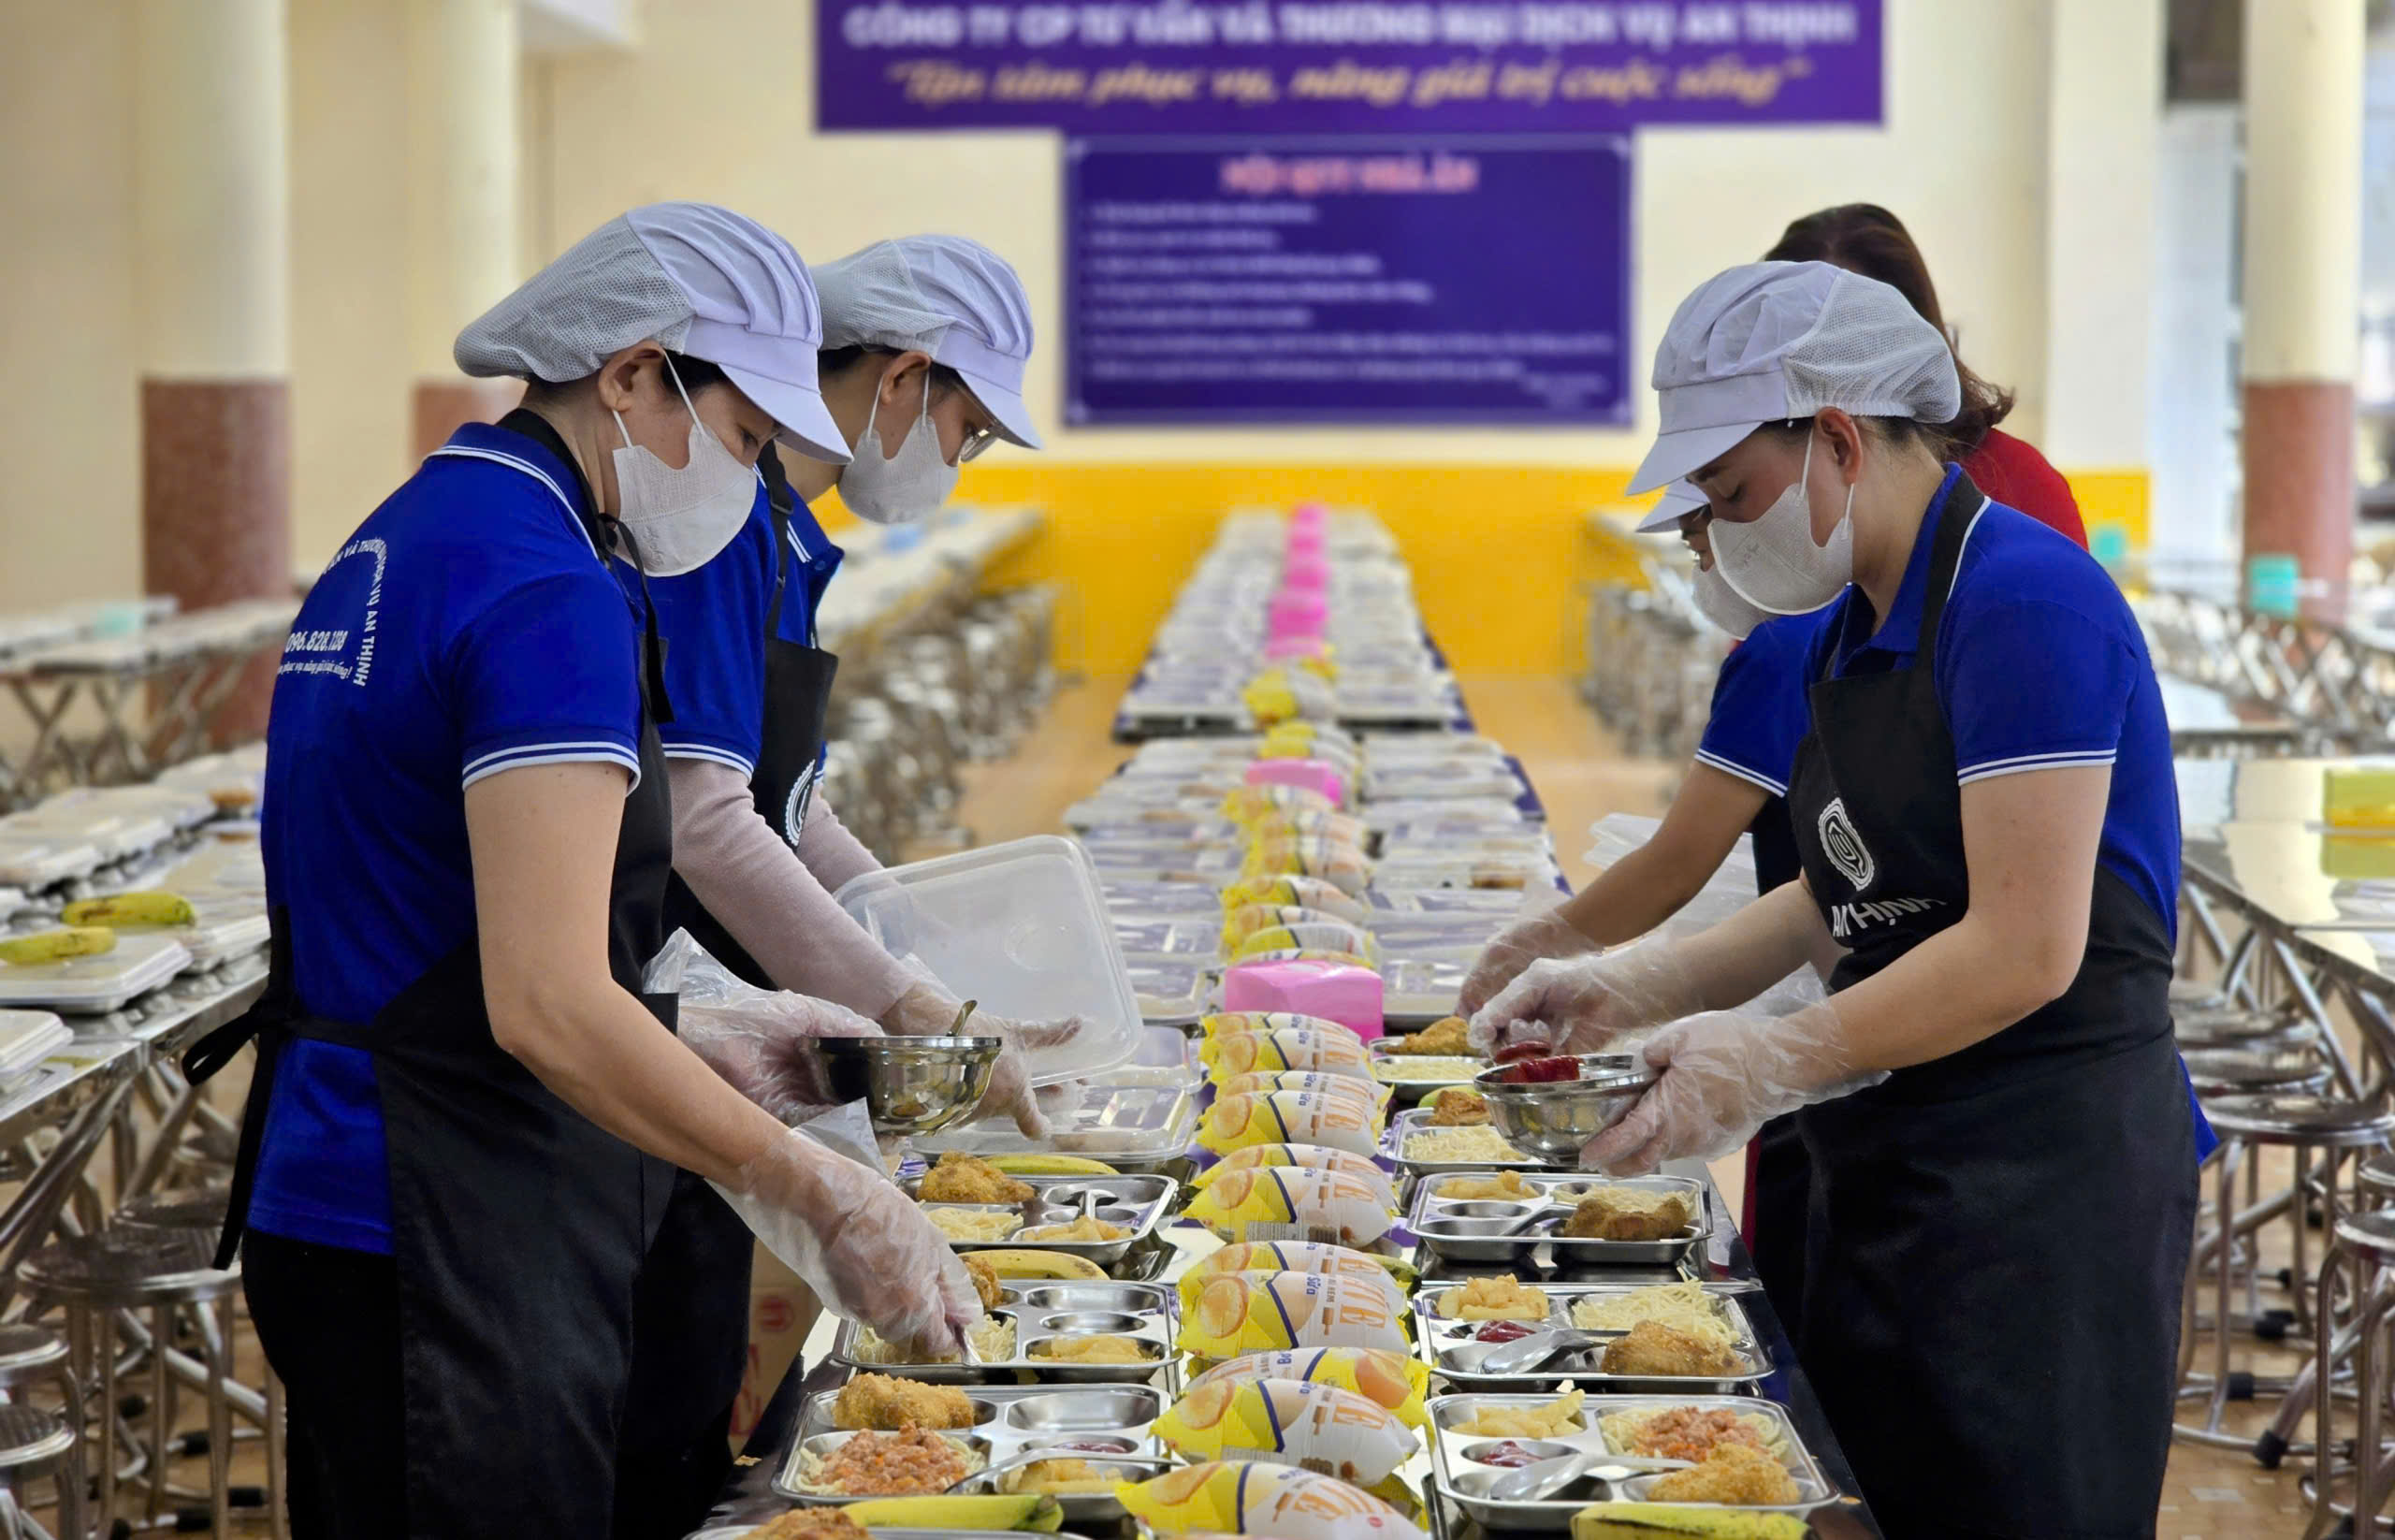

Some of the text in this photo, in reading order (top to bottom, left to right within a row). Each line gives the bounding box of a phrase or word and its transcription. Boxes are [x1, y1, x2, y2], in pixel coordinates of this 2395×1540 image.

[967, 7, 1010, 44] TY
[364, 610, 378, 632] AN
[353, 635, 375, 686] THỊNH
[1848, 897, 1947, 929] HỊNH
[1306, 1276, 1321, 1295] Sữa
